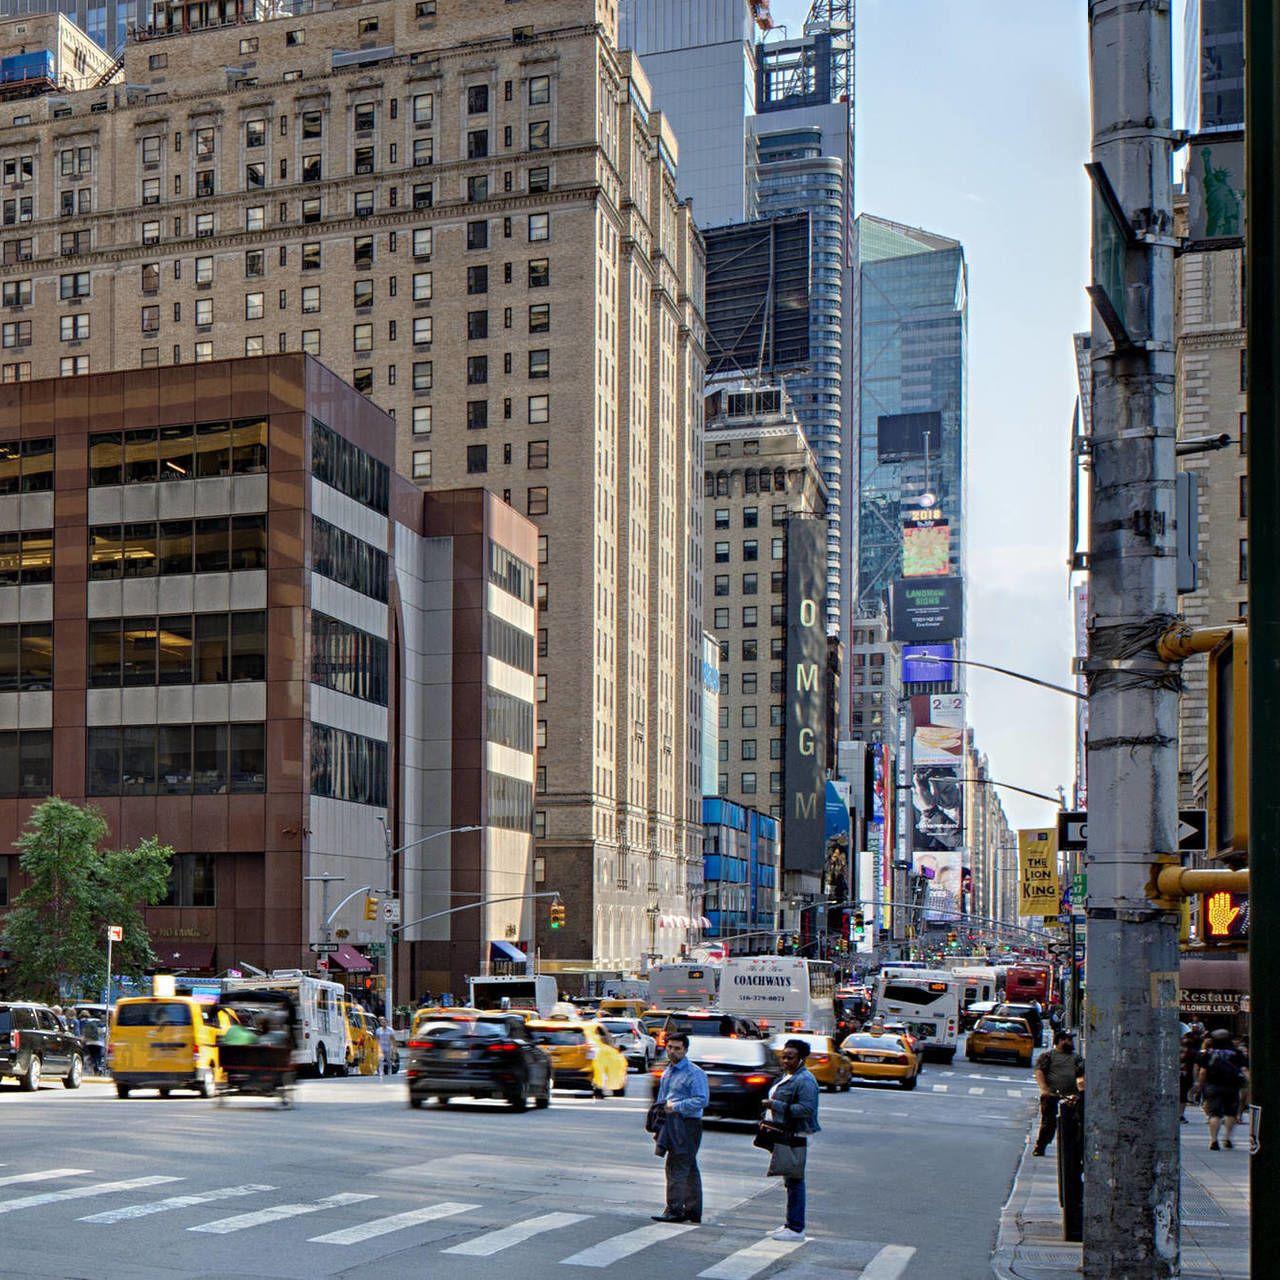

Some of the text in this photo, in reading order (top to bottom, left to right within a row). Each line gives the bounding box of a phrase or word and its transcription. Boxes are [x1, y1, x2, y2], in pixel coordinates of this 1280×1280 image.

[1027, 858, 1047, 868] THE
[1025, 868, 1051, 882] LION
[1023, 882, 1055, 898] KING
[734, 975, 791, 987] COACHWAYS
[1213, 1004, 1236, 1013] LEVEL
